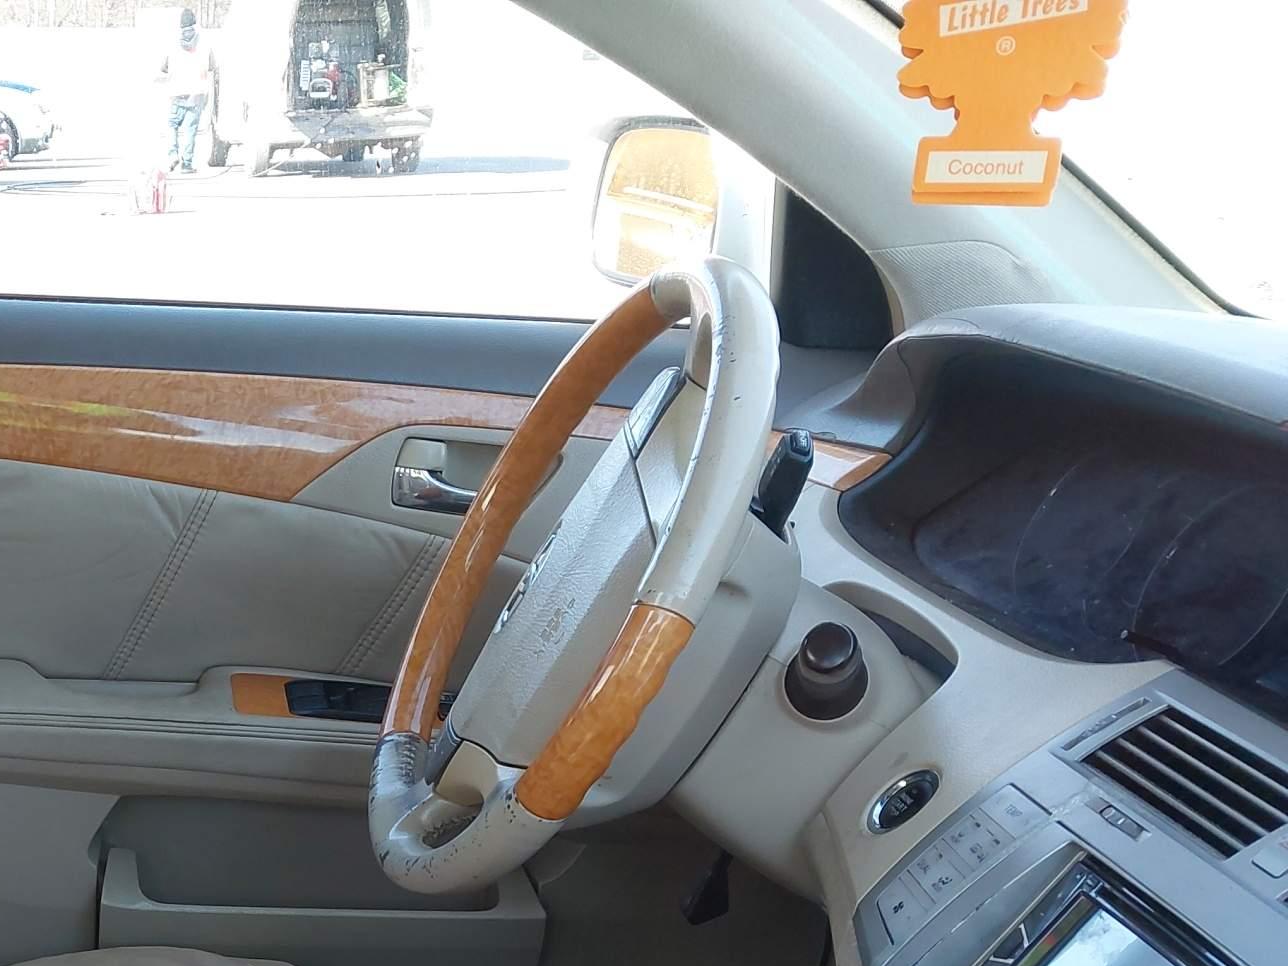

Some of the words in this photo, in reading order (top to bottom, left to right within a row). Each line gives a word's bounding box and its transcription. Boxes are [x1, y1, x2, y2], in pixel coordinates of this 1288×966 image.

[947, 0, 1010, 33] Little
[1021, 0, 1081, 19] Trees
[948, 158, 1024, 176] Coconut
